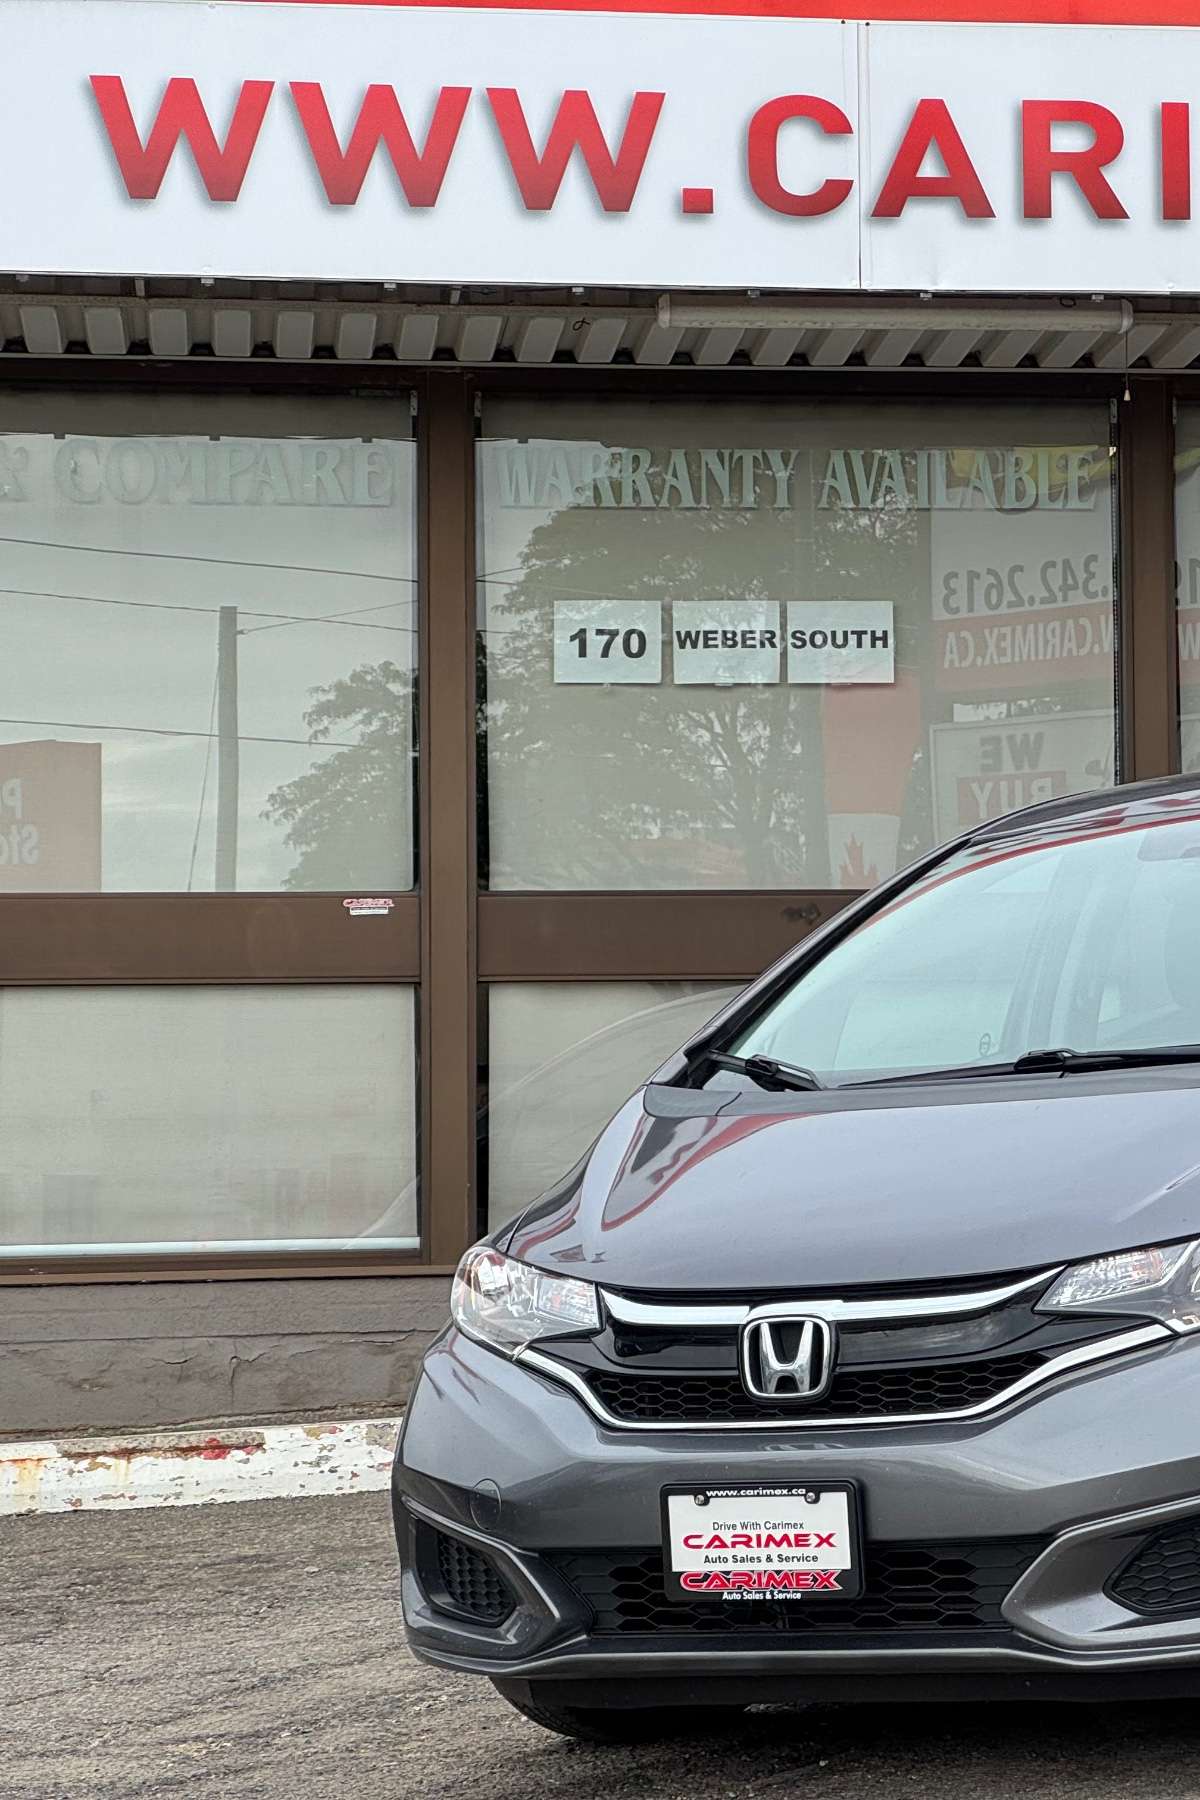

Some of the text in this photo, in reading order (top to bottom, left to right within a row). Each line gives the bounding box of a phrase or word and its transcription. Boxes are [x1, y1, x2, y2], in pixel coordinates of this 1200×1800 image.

[54, 438, 395, 508] COMPARE
[500, 447, 1098, 512] WARRANTY AVAILABLE
[568, 628, 889, 659] 170 WEBER SOUTH
[706, 1487, 807, 1497] www.carimex.ca
[712, 1521, 805, 1531] Drive With Carimex
[683, 1533, 838, 1549] CARIMEX
[704, 1553, 819, 1564] Auto Sales & Service
[680, 1569, 843, 1592] CARIMEX
[722, 1591, 802, 1600] Auto Sales & Service
